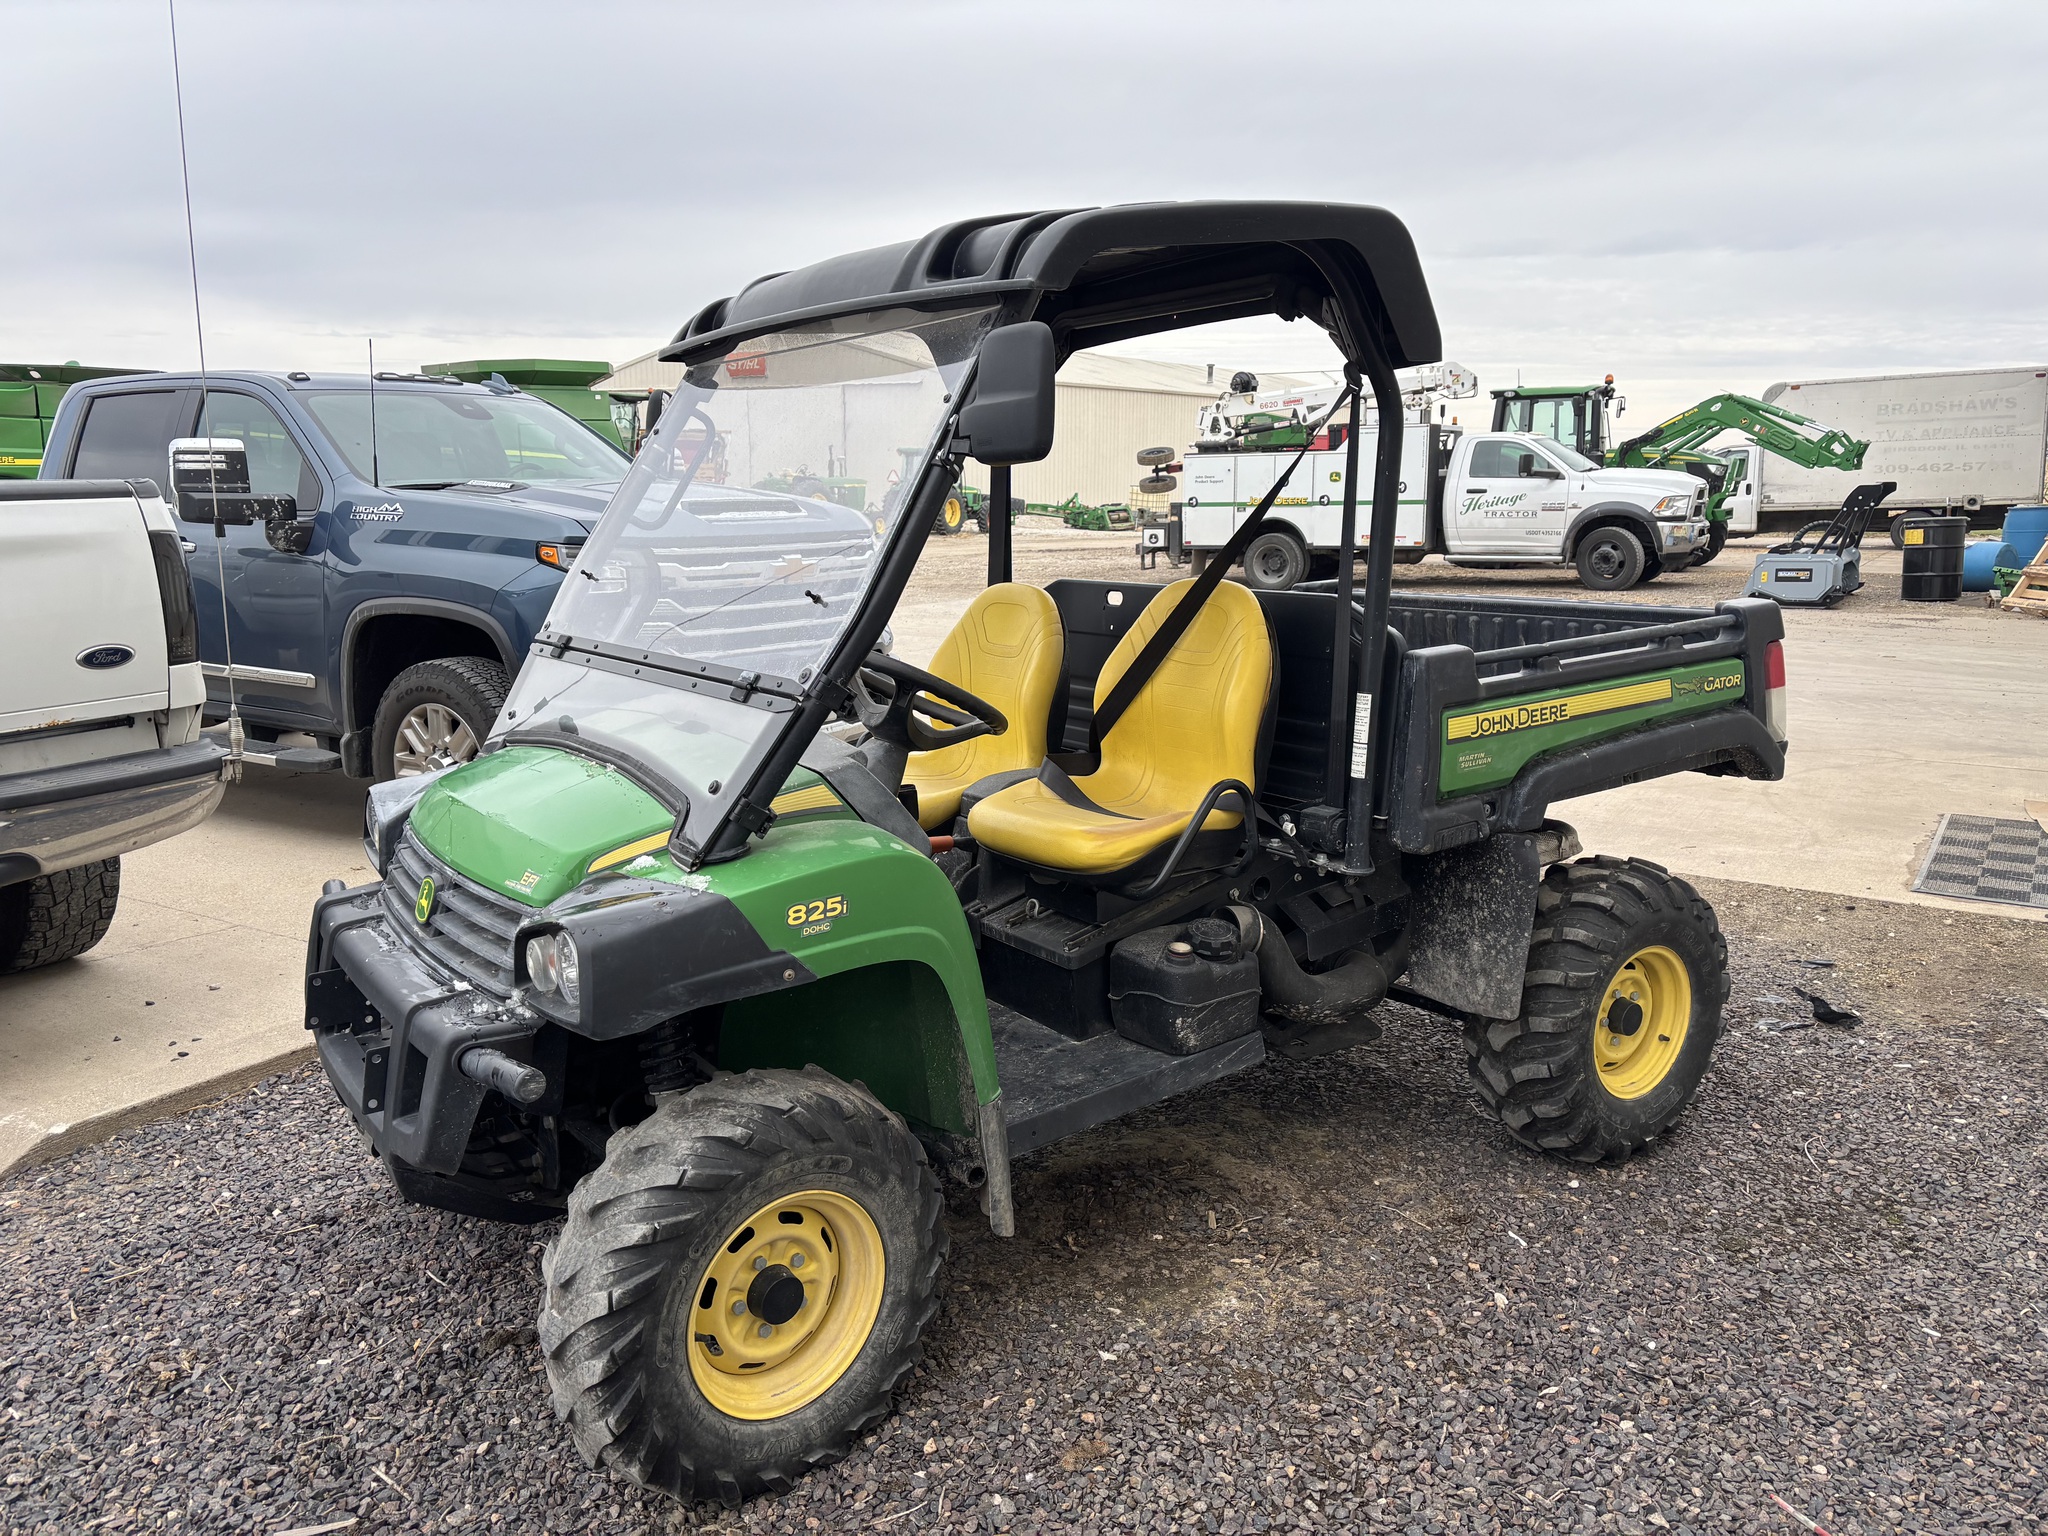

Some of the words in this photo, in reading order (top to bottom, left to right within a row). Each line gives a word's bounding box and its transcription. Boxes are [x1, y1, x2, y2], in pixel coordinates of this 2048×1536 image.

[1260, 401, 1279, 410] 6620
[1876, 397, 2018, 416] BRADSHAW'S
[1876, 429, 1896, 440] TV
[1903, 430, 1914, 439] &
[1921, 425, 2017, 438] APPLIANCE
[1873, 461, 2013, 474] 309-462-57
[1246, 496, 1263, 506] JO
[1274, 495, 1308, 505] DEERE
[1460, 493, 1527, 515] Heritage
[352, 505, 378, 513] HIGH
[1484, 510, 1538, 518] TRACTOR
[350, 512, 401, 522] COUNTRY
[92, 649, 122, 664] Ford
[1704, 673, 1742, 692] GATOR
[1470, 715, 1515, 736] JOHN
[1517, 703, 1569, 727] DEERE
[1458, 752, 1486, 763] MARTIN
[1460, 757, 1492, 769] SULLIVAN
[519, 871, 541, 888] EFI
[787, 895, 848, 926] 825i
[802, 922, 831, 936] DOHC
